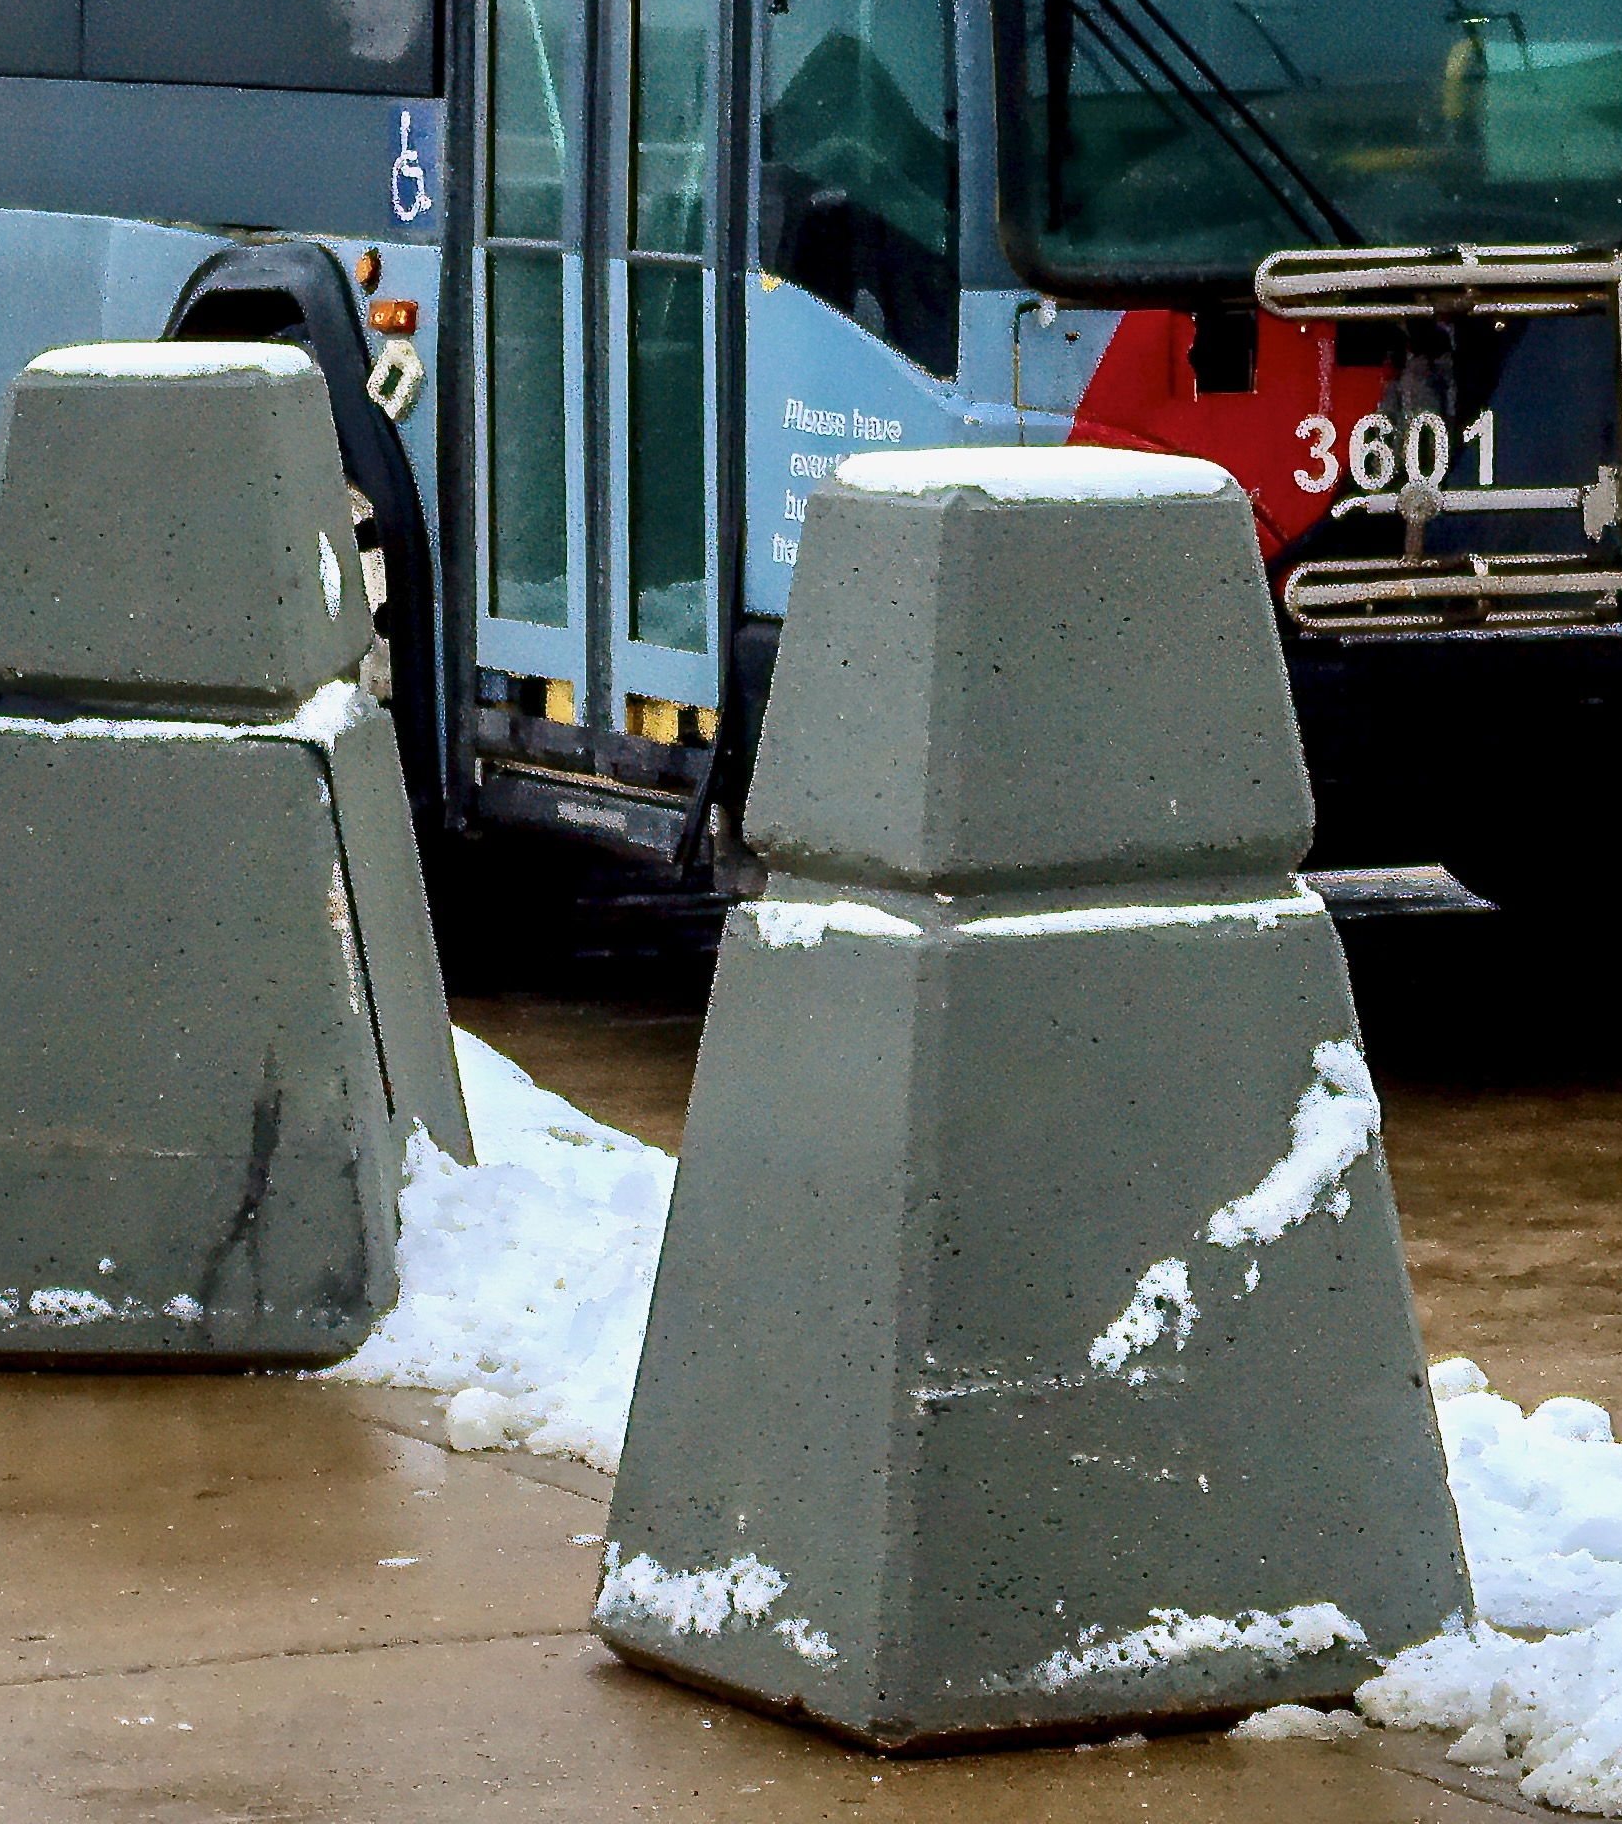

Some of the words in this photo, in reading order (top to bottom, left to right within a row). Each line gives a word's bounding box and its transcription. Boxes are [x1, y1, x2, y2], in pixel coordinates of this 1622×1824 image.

[782, 398, 846, 437] Please
[852, 408, 902, 443] have
[1293, 410, 1494, 493] 3601
